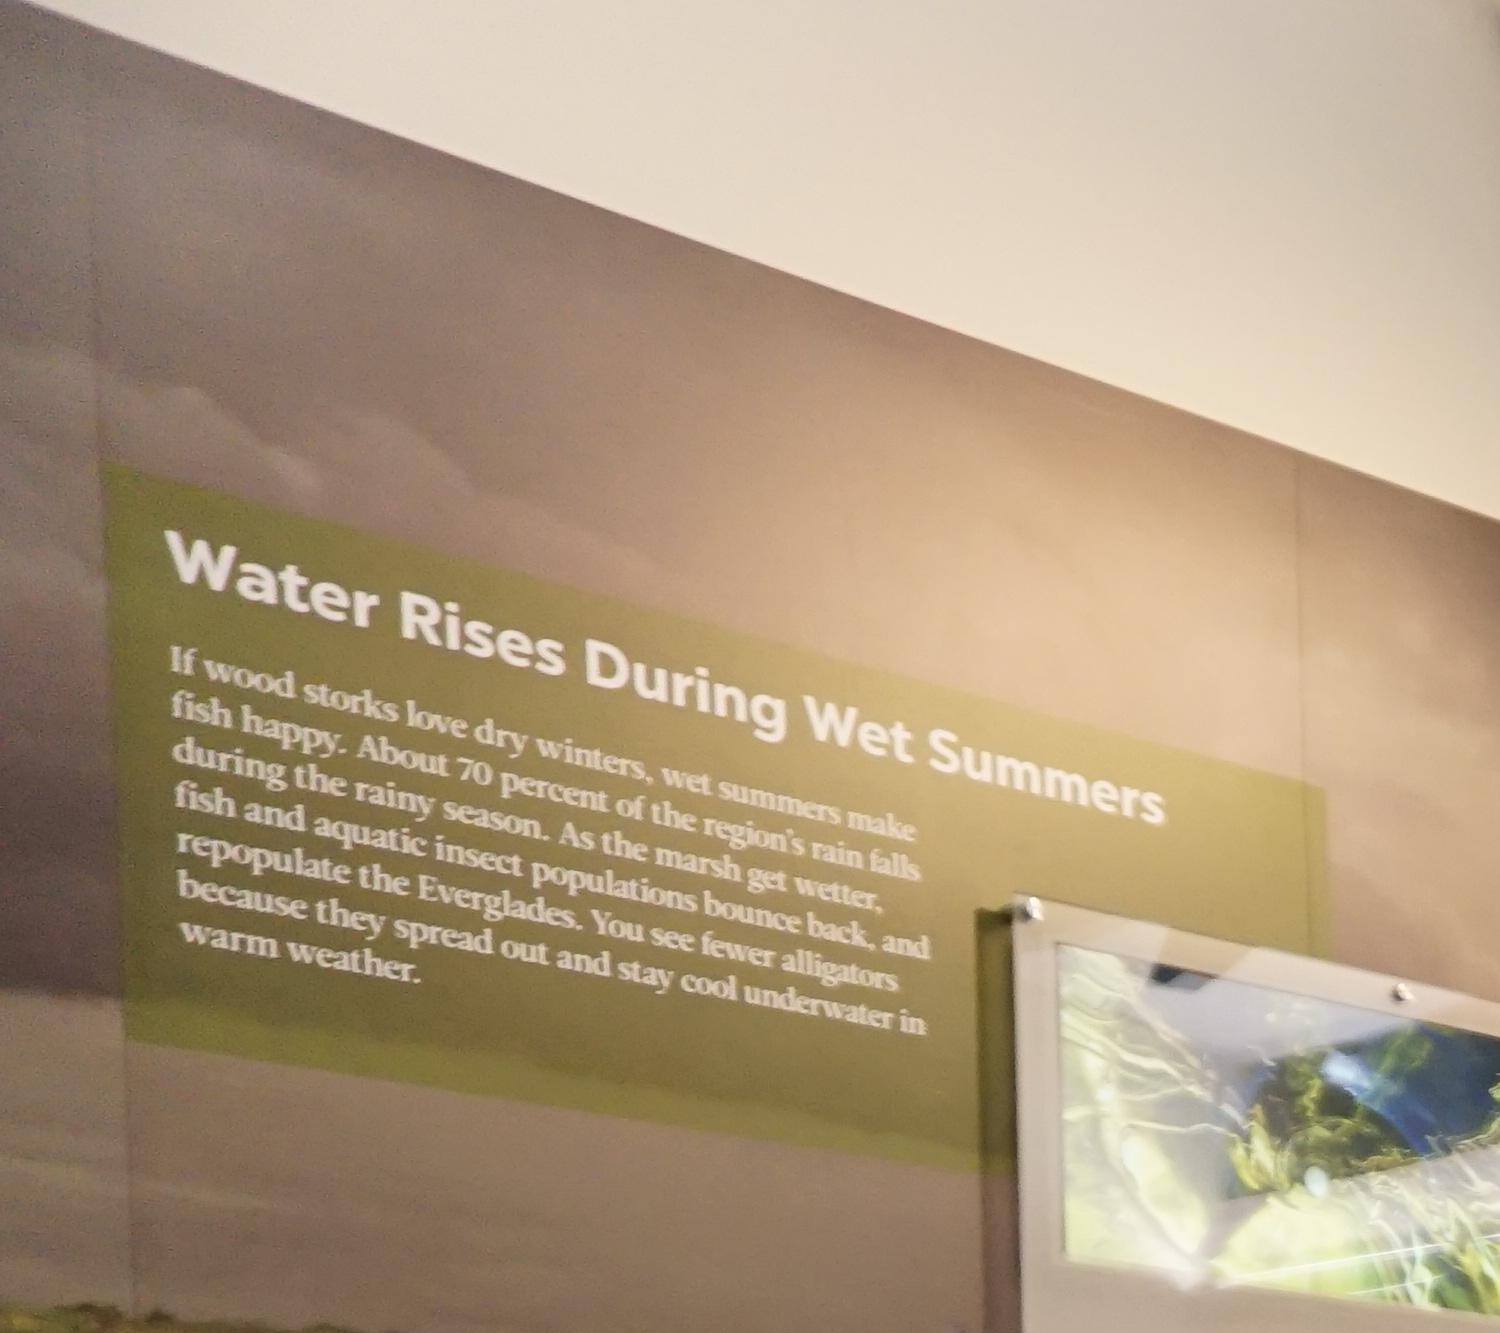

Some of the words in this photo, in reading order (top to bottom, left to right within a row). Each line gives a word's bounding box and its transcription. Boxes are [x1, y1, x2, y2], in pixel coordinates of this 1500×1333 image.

[164, 529, 380, 628] Water
[399, 590, 566, 676] Rises
[585, 638, 786, 743] During
[805, 695, 911, 763] Wet
[931, 729, 1163, 824] Summers
[169, 644, 198, 677] If
[202, 659, 297, 699] wood
[302, 683, 400, 723] storks
[405, 699, 469, 739] love
[473, 717, 528, 759] dry
[535, 737, 654, 785] winters,
[661, 767, 712, 796] wet
[718, 781, 841, 825] summers
[847, 811, 915, 842] make
[171, 689, 234, 729] fish
[240, 703, 347, 759] happy.
[356, 734, 450, 778] About
[456, 756, 494, 786] 70
[500, 771, 610, 813] percent
[615, 795, 645, 822] of
[650, 800, 697, 832] the
[702, 817, 805, 856] region's
[811, 840, 864, 869] rain
[869, 848, 920, 881] falls
[171, 735, 289, 792] during
[293, 762, 348, 797] the
[354, 781, 436, 823] rainy
[442, 801, 550, 842] season.
[559, 821, 596, 851] As
[600, 830, 649, 862] the
[654, 847, 742, 883] marsh
[746, 867, 788, 895] get
[794, 876, 883, 915] wetter,
[173, 779, 237, 818] fish
[243, 802, 307, 833] and
[313, 816, 428, 857] aquatic
[434, 834, 524, 877] insect
[530, 861, 698, 913] populations
[702, 889, 802, 934] bounce
[806, 911, 876, 951] back,
[882, 934, 931, 960] and
[176, 832, 352, 885] repopulate
[357, 863, 411, 897] the
[417, 873, 583, 931] Everglades.
[590, 908, 645, 943] You
[649, 927, 695, 953] see
[701, 930, 777, 968] fewer
[781, 948, 899, 992] alligators
[176, 868, 309, 920] because
[314, 897, 386, 941] they
[393, 918, 495, 955] spread
[500, 939, 550, 966] out
[556, 950, 612, 978] and
[617, 961, 675, 995] stay
[680, 974, 739, 1001] cool
[743, 985, 895, 1030] underwater
[899, 1008, 927, 1036] in
[179, 921, 280, 959] warm
[286, 941, 422, 984] weather.
